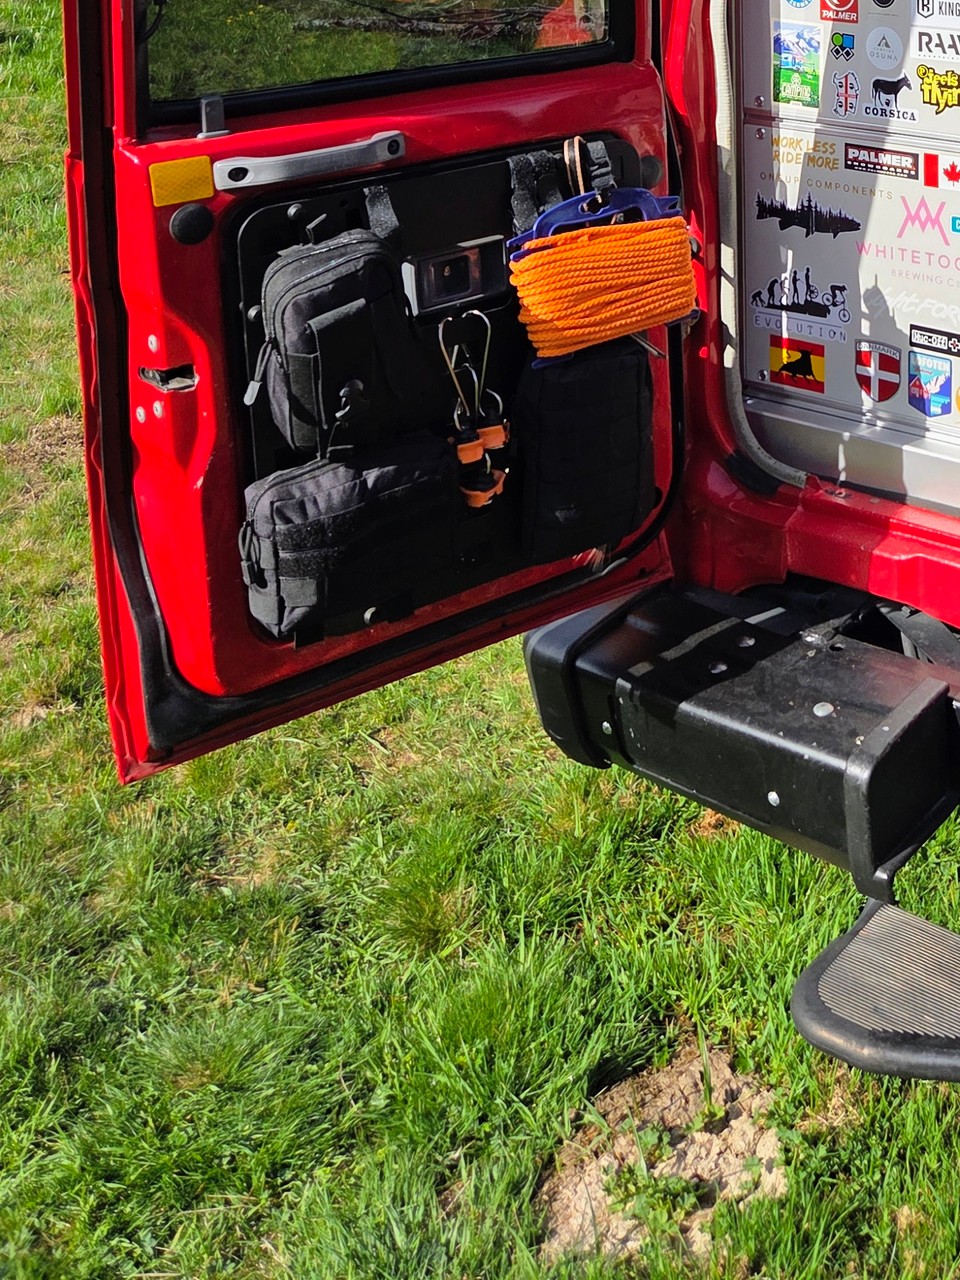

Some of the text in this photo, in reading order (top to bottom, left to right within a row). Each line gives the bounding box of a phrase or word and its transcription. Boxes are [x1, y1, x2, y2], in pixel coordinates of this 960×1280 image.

[822, 9, 858, 21] PALMER
[869, 51, 899, 62] OSUNA
[864, 106, 916, 121] CORSICA
[771, 136, 836, 155] WORK LESS
[773, 150, 840, 171] RIDE MORE
[847, 148, 914, 169] PALMER
[806, 177, 894, 200] COMPONENTS
[891, 268, 943, 286] BREWING
[754, 315, 848, 342] EVOLUTION
[912, 330, 948, 348] Muc-Off
[856, 342, 899, 358] DANMARK
